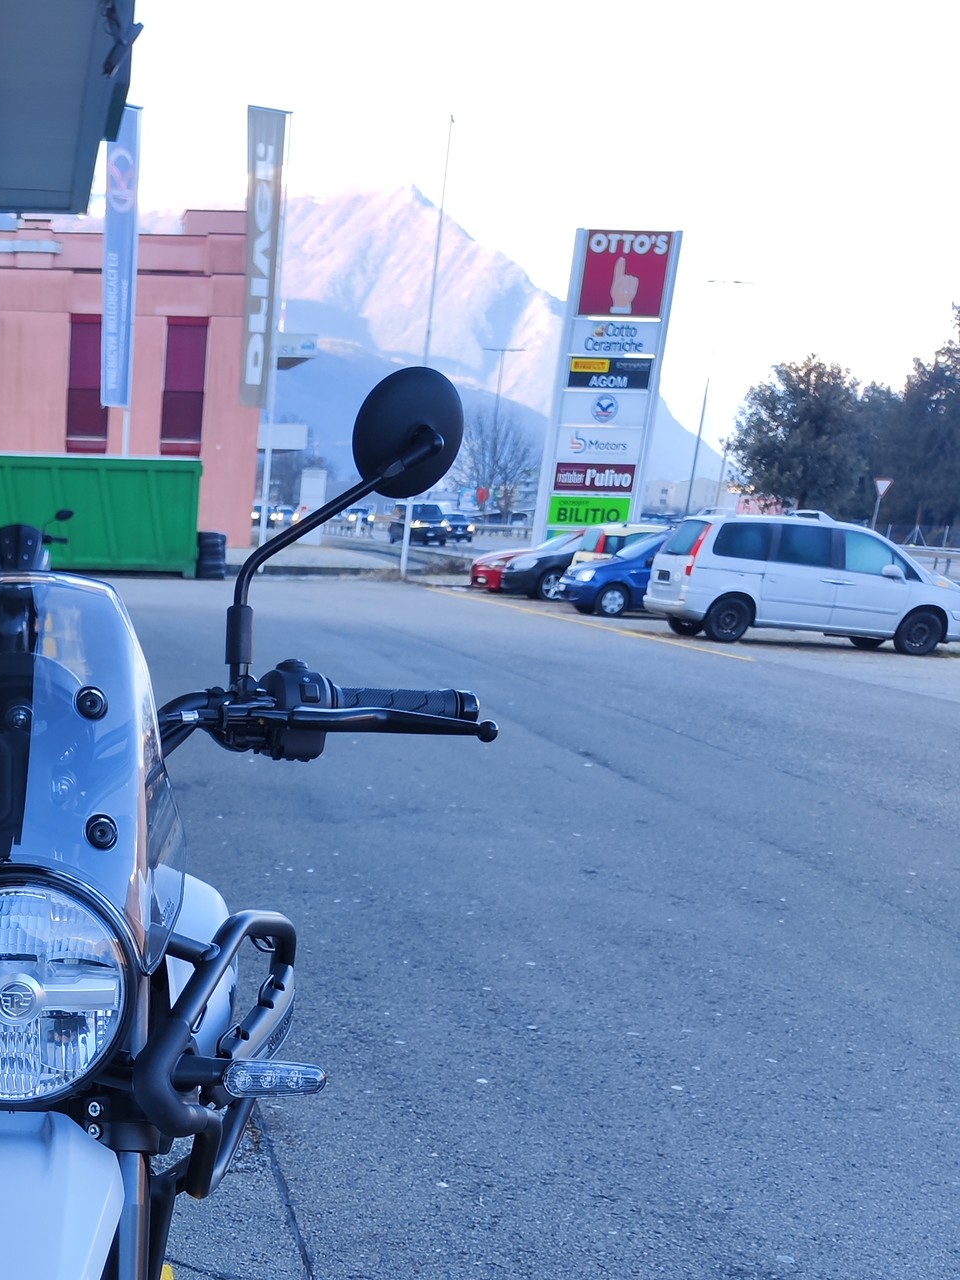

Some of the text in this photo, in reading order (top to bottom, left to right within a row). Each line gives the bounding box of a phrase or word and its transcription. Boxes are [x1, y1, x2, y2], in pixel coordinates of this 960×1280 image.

[589, 232, 669, 256] OTTO'S
[605, 322, 638, 338] Cotto
[584, 336, 644, 353] Ceramiche
[588, 375, 629, 388] AGOM
[588, 439, 628, 451] Motors
[557, 507, 620, 523] BILITIO
